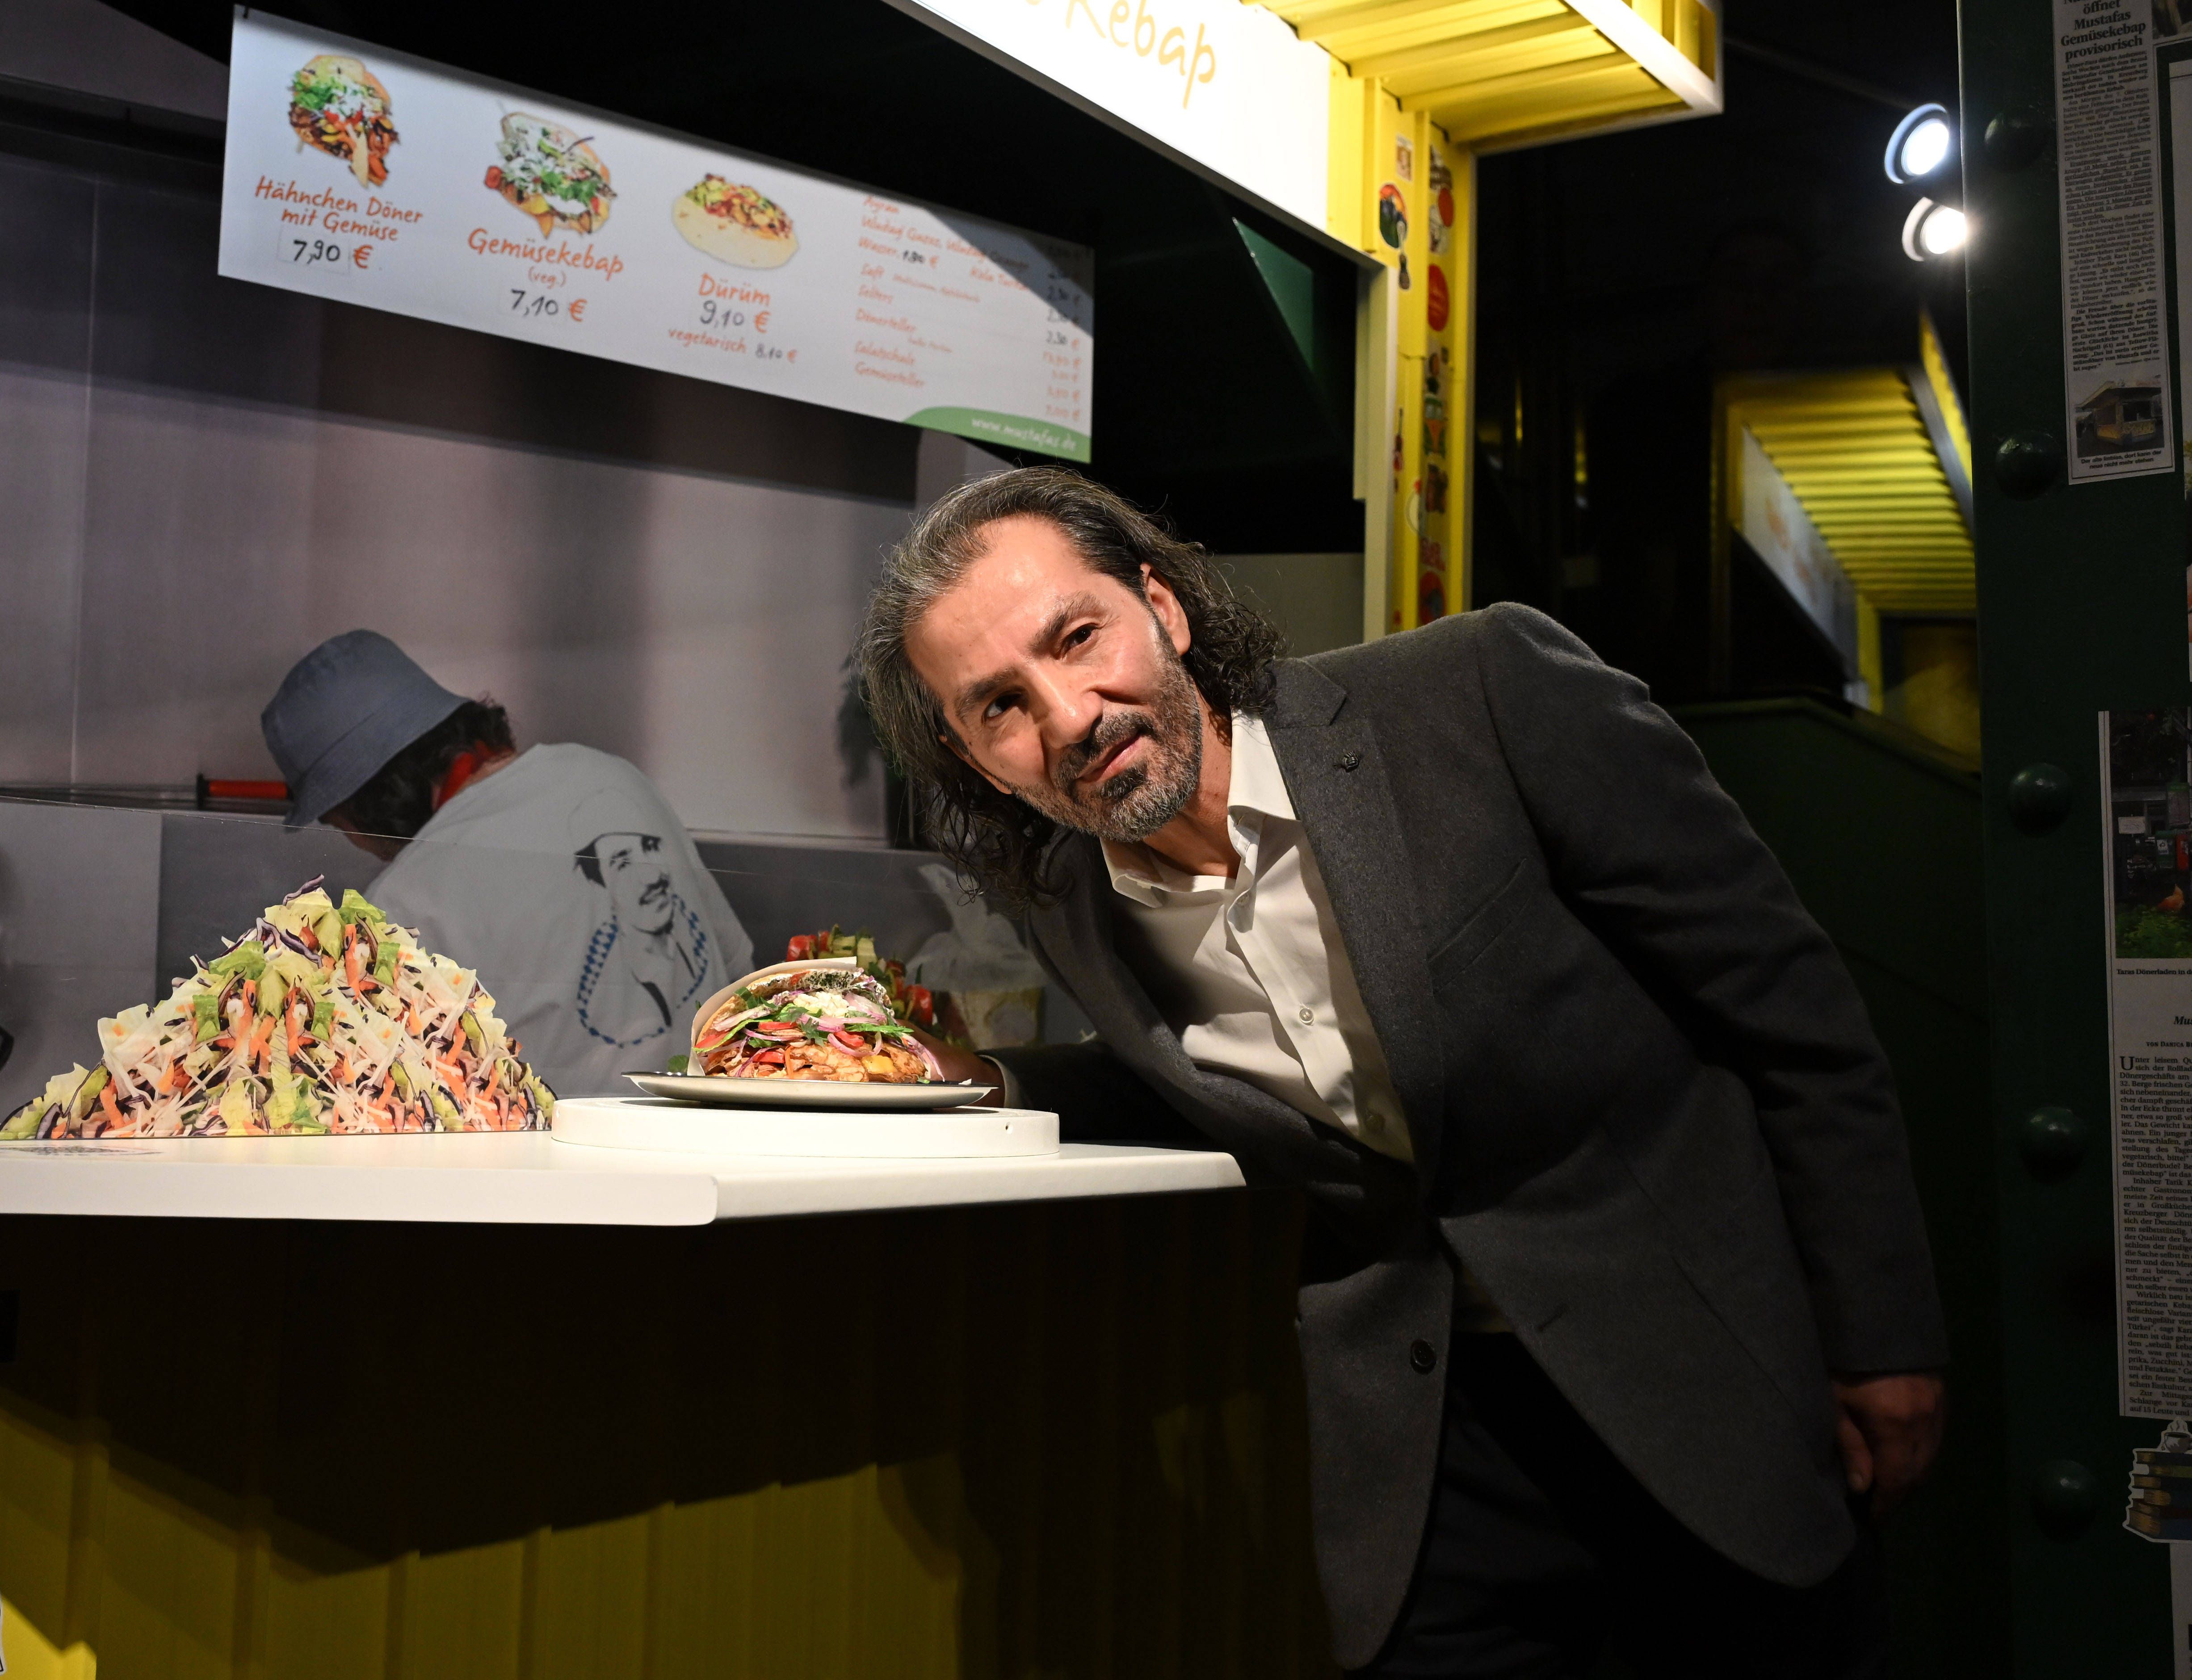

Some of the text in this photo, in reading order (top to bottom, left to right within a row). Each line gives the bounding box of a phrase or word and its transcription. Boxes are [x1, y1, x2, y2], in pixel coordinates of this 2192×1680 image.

[2083, 0, 2121, 14] öffnet
[2074, 10, 2131, 30] Mustafas
[2061, 23, 2146, 46] Gemüsekebap
[2065, 35, 2142, 63] provisorisch
[255, 175, 424, 223] Hähnchen Döner
[281, 208, 399, 241] mit Gemüse
[353, 245, 374, 269] €
[468, 227, 624, 282] Gemüsekebap
[528, 265, 567, 289] (veg.)
[698, 272, 770, 306] Dürüm
[510, 288, 588, 322] 7,10 €
[700, 299, 771, 334] 9,10 €
[668, 328, 747, 354] vegetarisch
[2120, 1072, 2175, 1081] Dönergeschäfts
[2124, 1209, 2167, 1218] Kreuzberger
[2156, 1268, 2181, 1276] bieten,
[2127, 1300, 2168, 1308] getarischen
[2137, 1291, 2166, 1299] Wirklich
[2150, 1357, 2184, 1366] Zucchini,
[2129, 1397, 2162, 1407] Schlange
